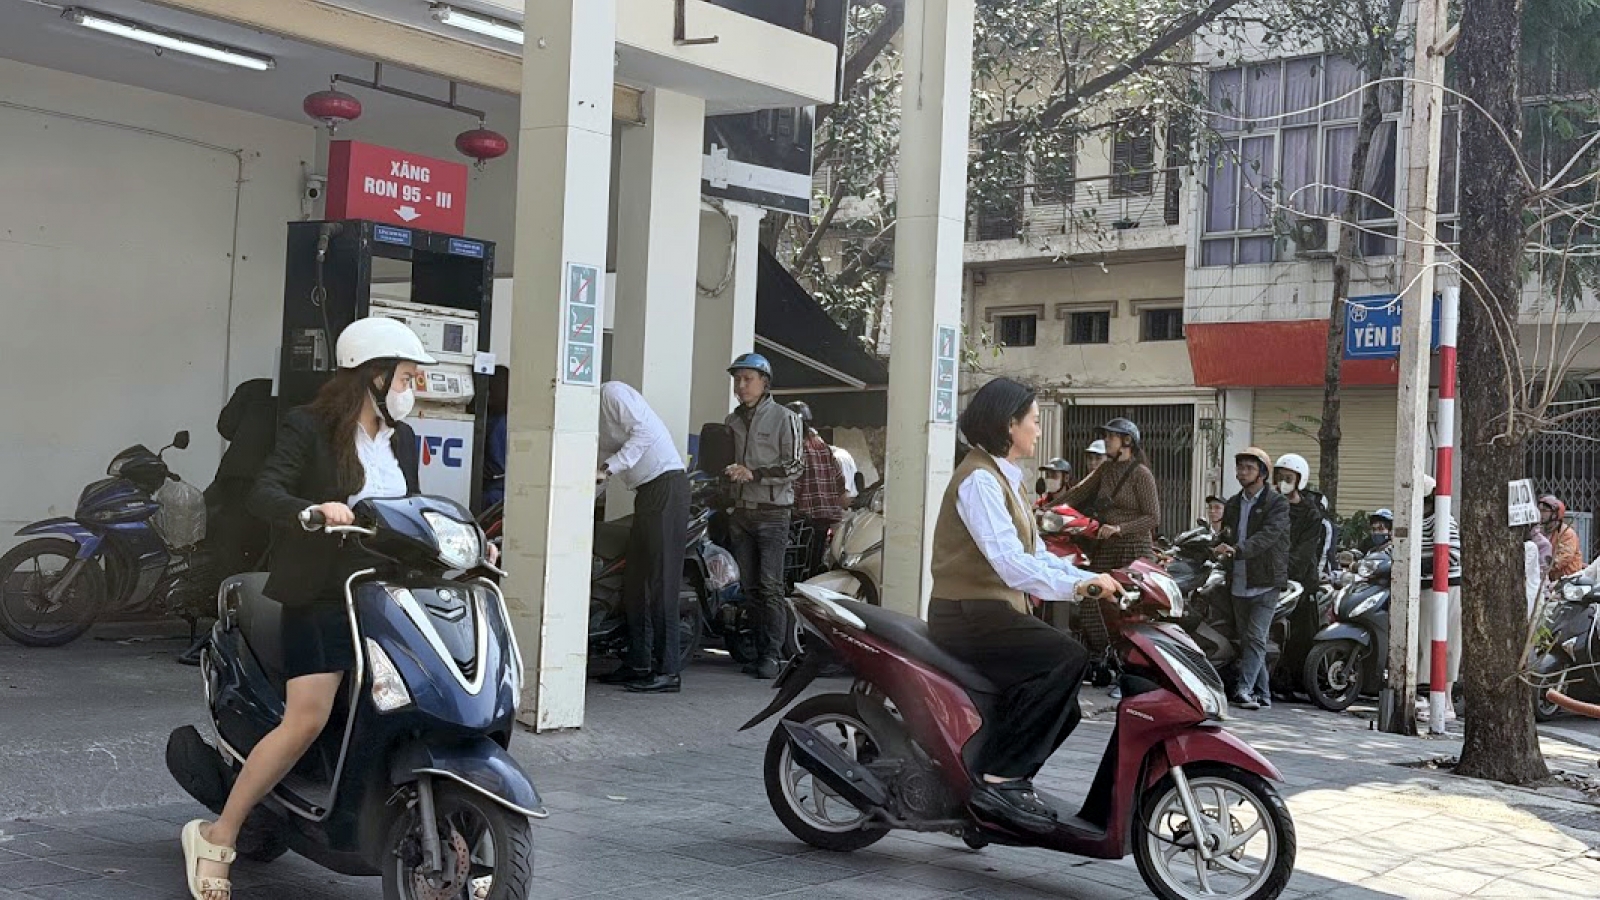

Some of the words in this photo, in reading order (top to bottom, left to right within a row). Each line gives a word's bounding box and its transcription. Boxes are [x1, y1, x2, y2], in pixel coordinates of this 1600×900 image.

[390, 160, 430, 183] XĂNG
[364, 176, 398, 199] RON
[402, 185, 421, 203] 95
[436, 191, 452, 209] III
[1387, 305, 1403, 316] PH
[1354, 322, 1387, 348] YÊN
[1391, 326, 1401, 346] B
[414, 435, 464, 468] FC
